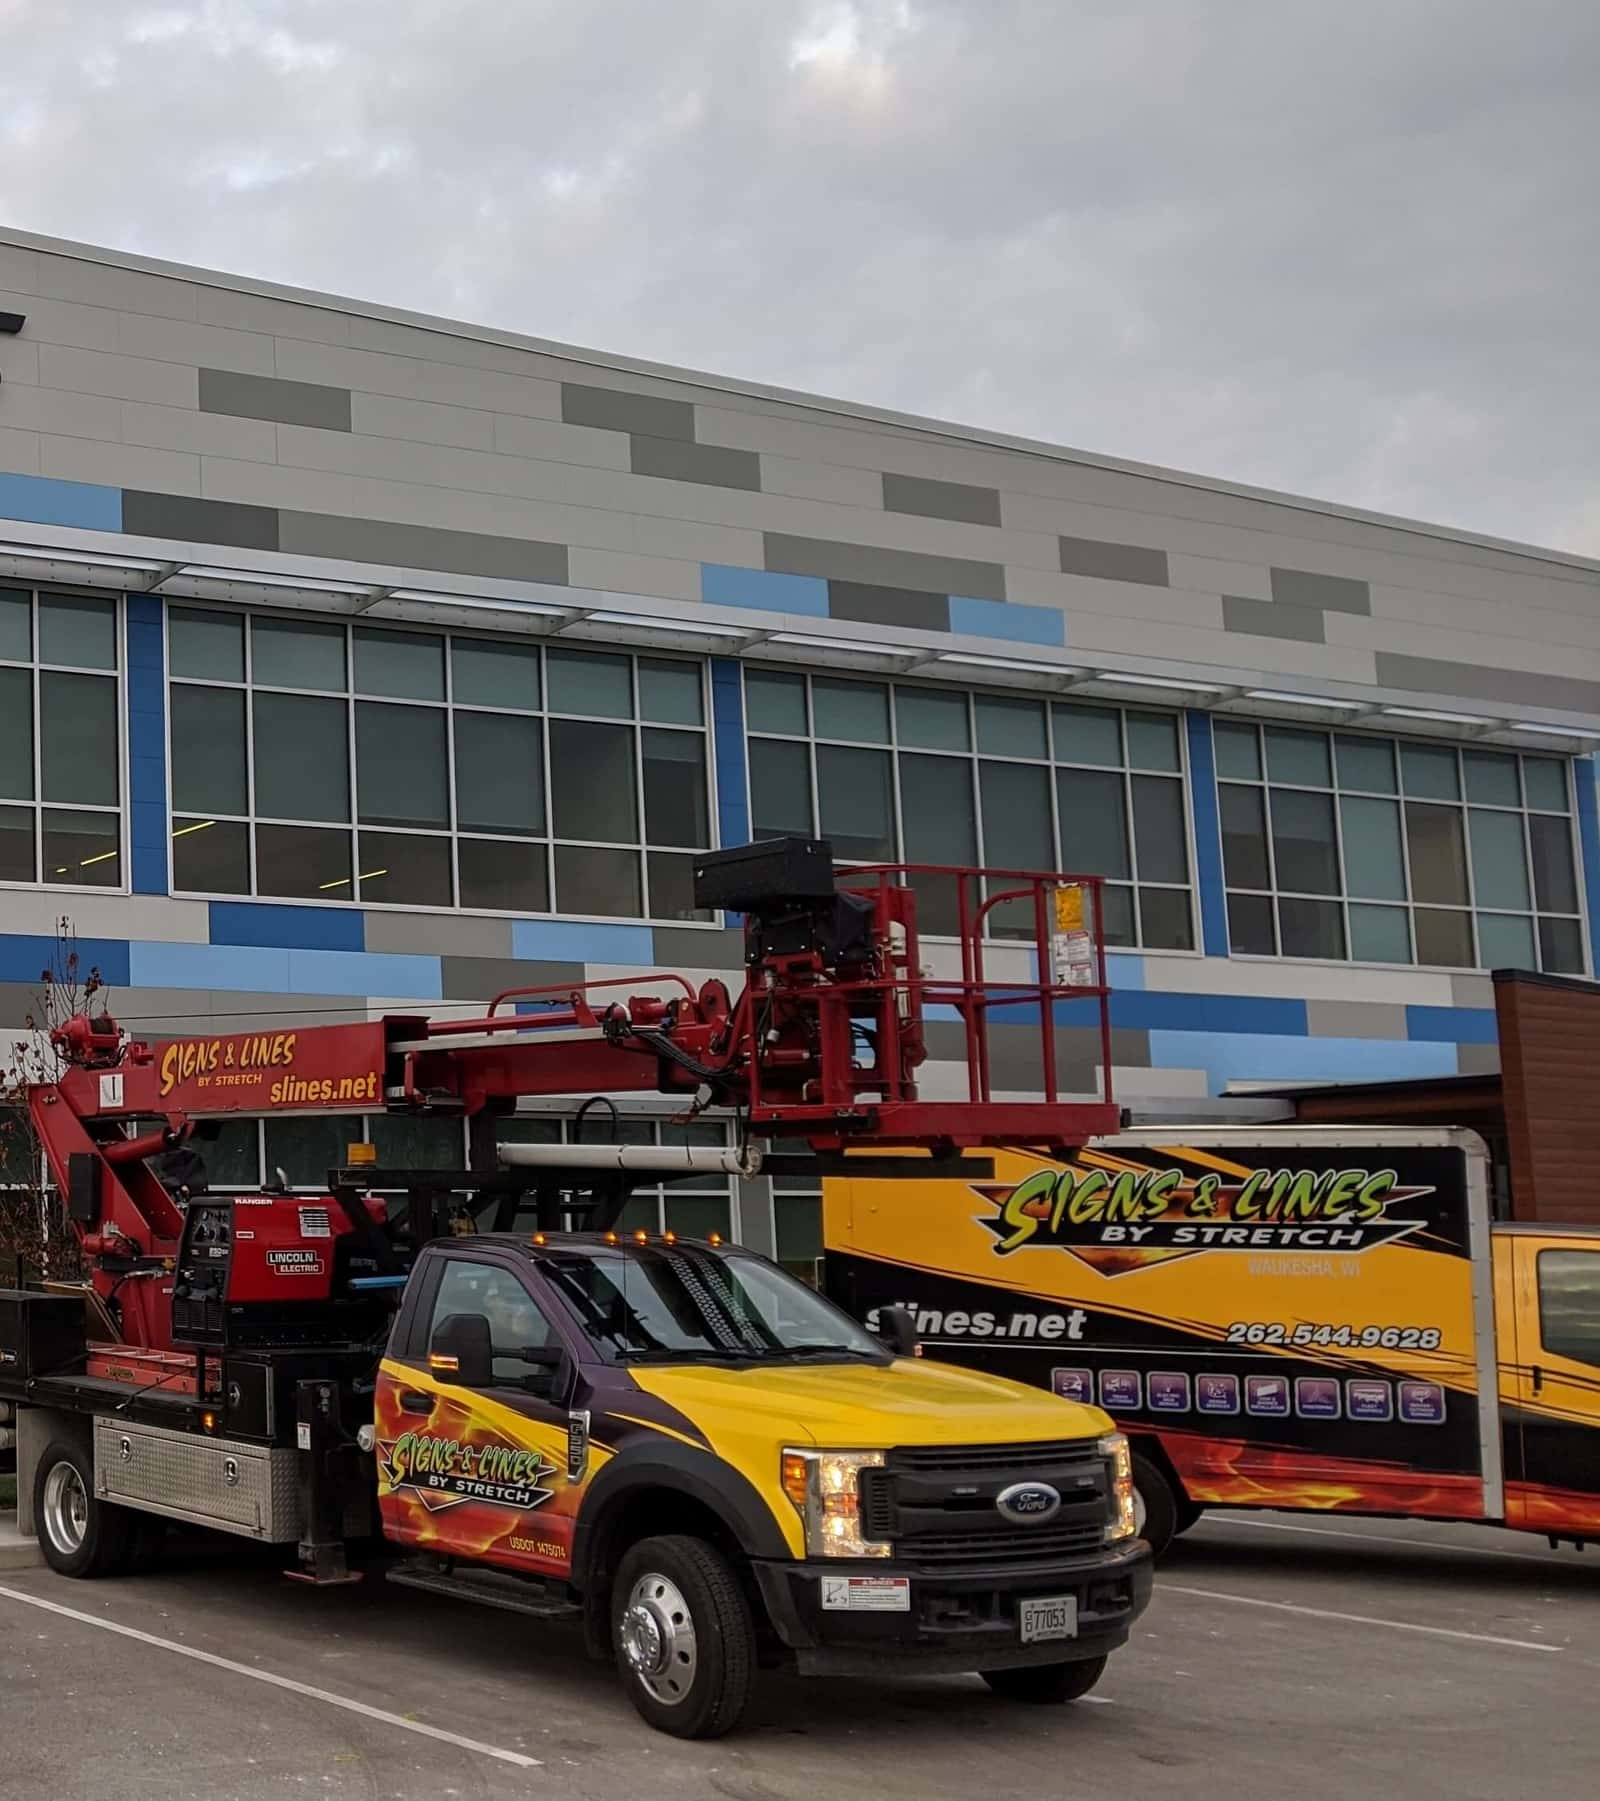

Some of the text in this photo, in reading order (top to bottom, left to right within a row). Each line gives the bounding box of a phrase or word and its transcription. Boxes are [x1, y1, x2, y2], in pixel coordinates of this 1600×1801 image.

[160, 1033, 297, 1096] SIGNS & LINES
[198, 1073, 263, 1087] BY STRETCH
[270, 1071, 377, 1103] slines.net
[996, 1170, 1395, 1254] SIGNS & LINES
[1100, 1225, 1364, 1246] BY STRETCH
[269, 1253, 314, 1263] LINCOLN
[280, 1264, 320, 1273] ELECTRIC
[1343, 1261, 1361, 1276] WI
[1227, 1323, 1442, 1350] 262.544.9628
[391, 1433, 542, 1489] SIGNS & LINES
[428, 1476, 531, 1503] BY STRETCH
[1017, 1492, 1048, 1514] Ford
[509, 1536, 535, 1553] USDOT
[1033, 1608, 1067, 1630] 77053
